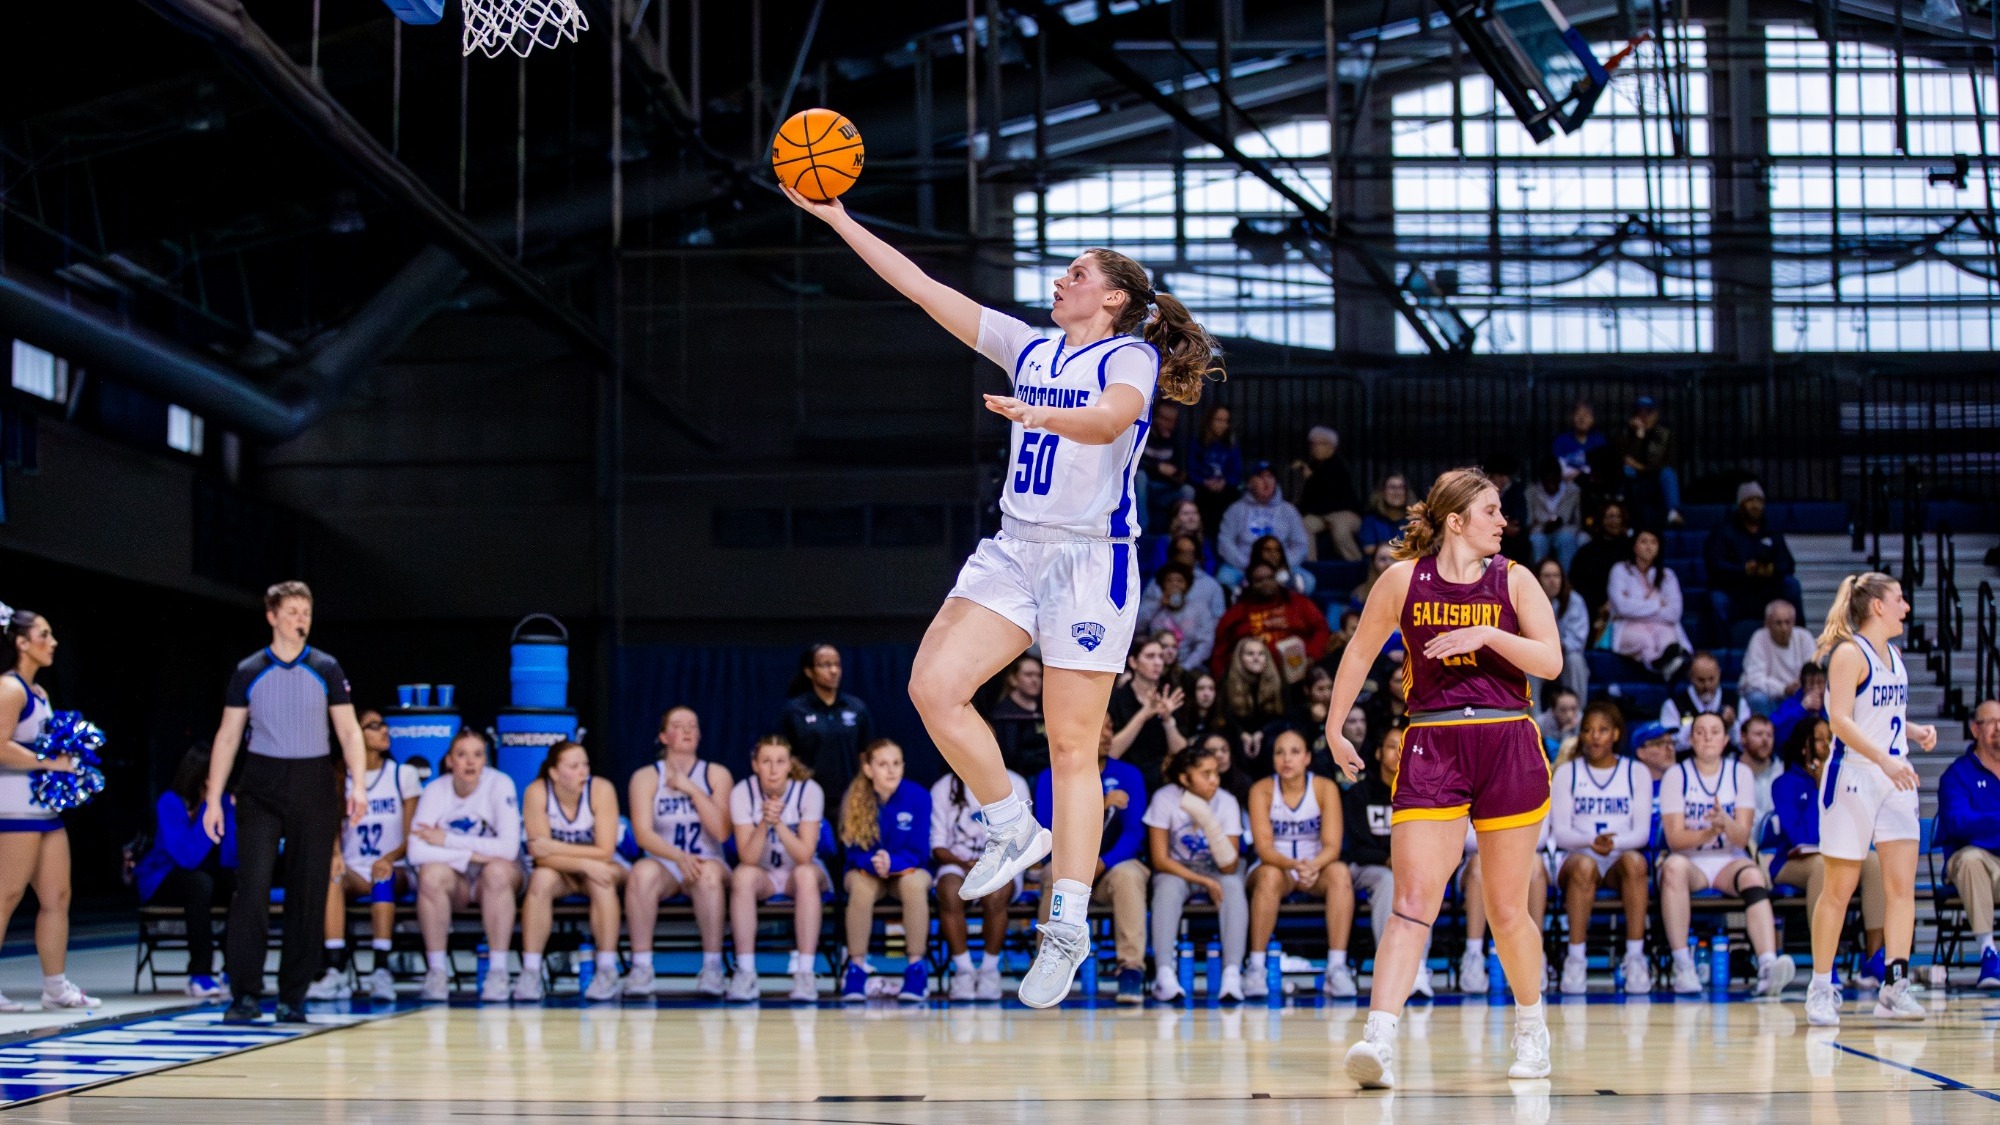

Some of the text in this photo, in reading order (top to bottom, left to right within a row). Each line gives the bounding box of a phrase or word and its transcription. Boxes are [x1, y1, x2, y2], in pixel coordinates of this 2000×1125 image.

[1014, 431, 1060, 496] 50
[1413, 601, 1502, 628] SALISBURY
[1071, 621, 1105, 640] CNU
[389, 725, 451, 738] OWERADE
[1888, 716, 1901, 755] 2
[1574, 797, 1629, 815] CAPTAINS
[357, 823, 382, 856] 32
[674, 822, 702, 854] 42
[1271, 816, 1322, 836] APTAINS
